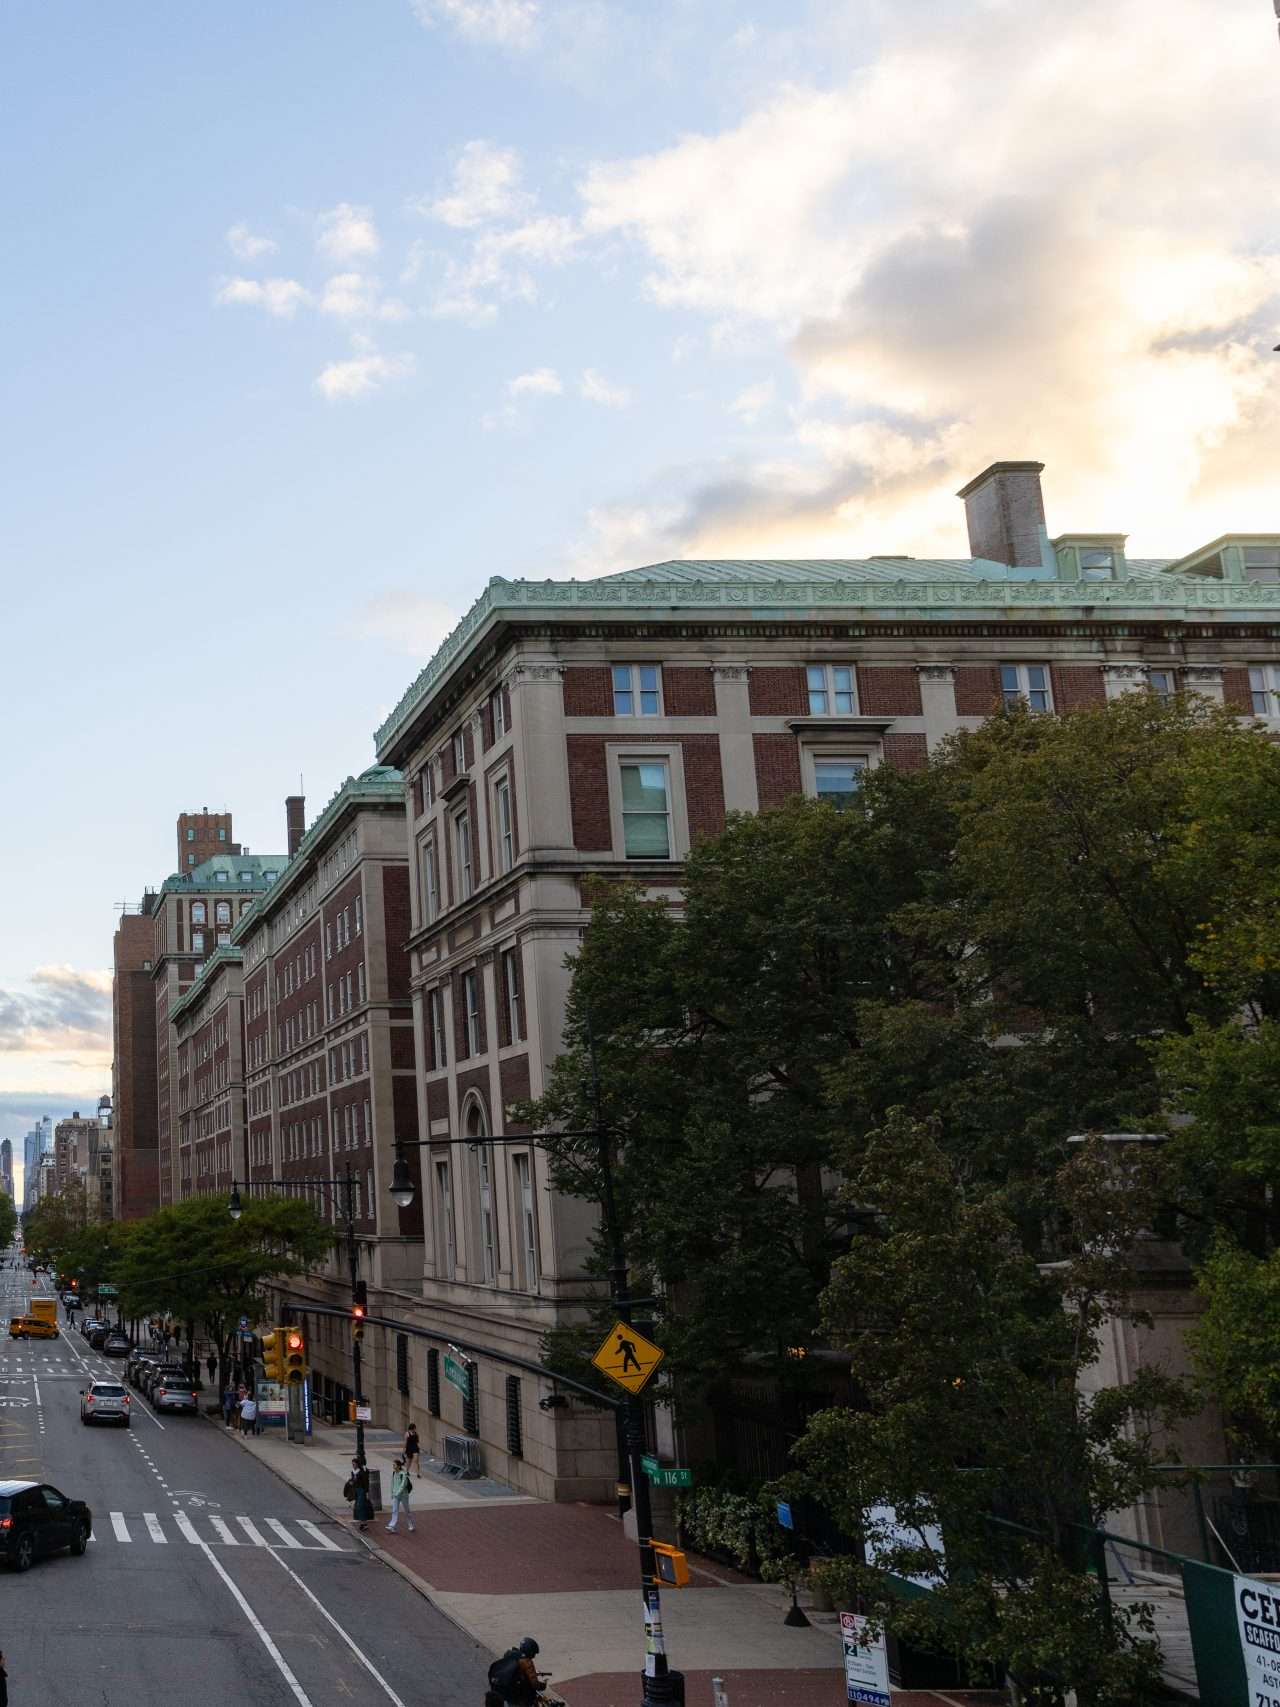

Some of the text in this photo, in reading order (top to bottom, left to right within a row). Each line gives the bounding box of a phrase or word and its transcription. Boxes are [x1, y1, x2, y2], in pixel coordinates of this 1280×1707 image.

[664, 1471, 678, 1486] 116
[1263, 1673, 1280, 1688] AST
[850, 1690, 880, 1704] 110494
